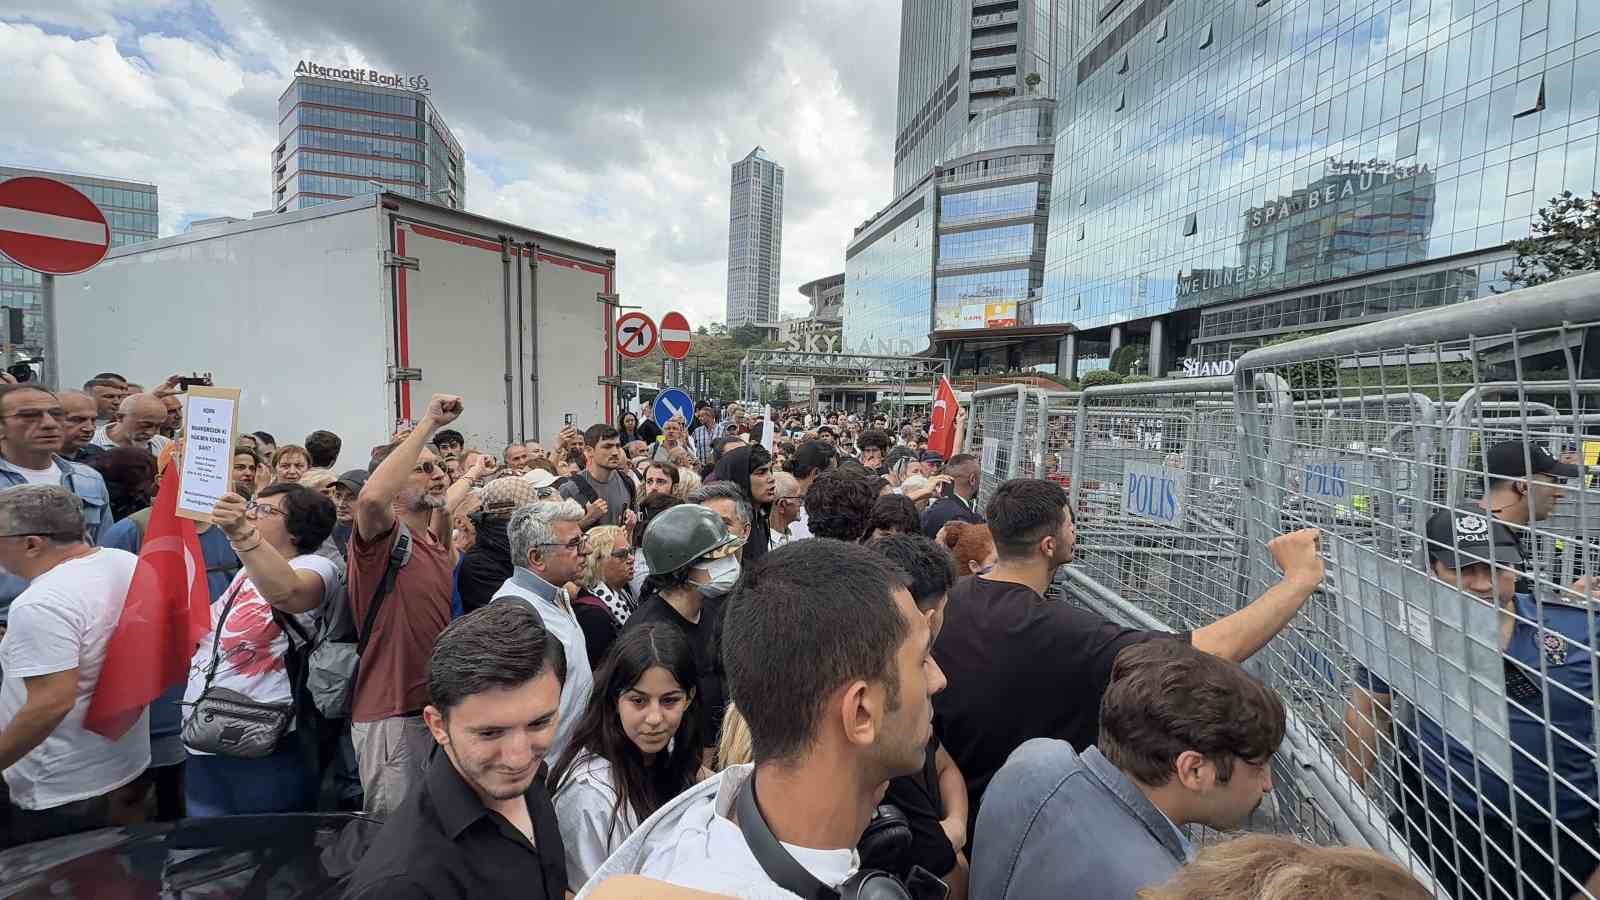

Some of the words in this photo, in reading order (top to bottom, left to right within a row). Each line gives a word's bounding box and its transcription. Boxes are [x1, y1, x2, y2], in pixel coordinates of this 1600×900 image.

[296, 60, 366, 81] Alternatif
[369, 71, 402, 88] Bank
[1252, 201, 1290, 227] SPA
[1181, 258, 1272, 296] WELLNESS
